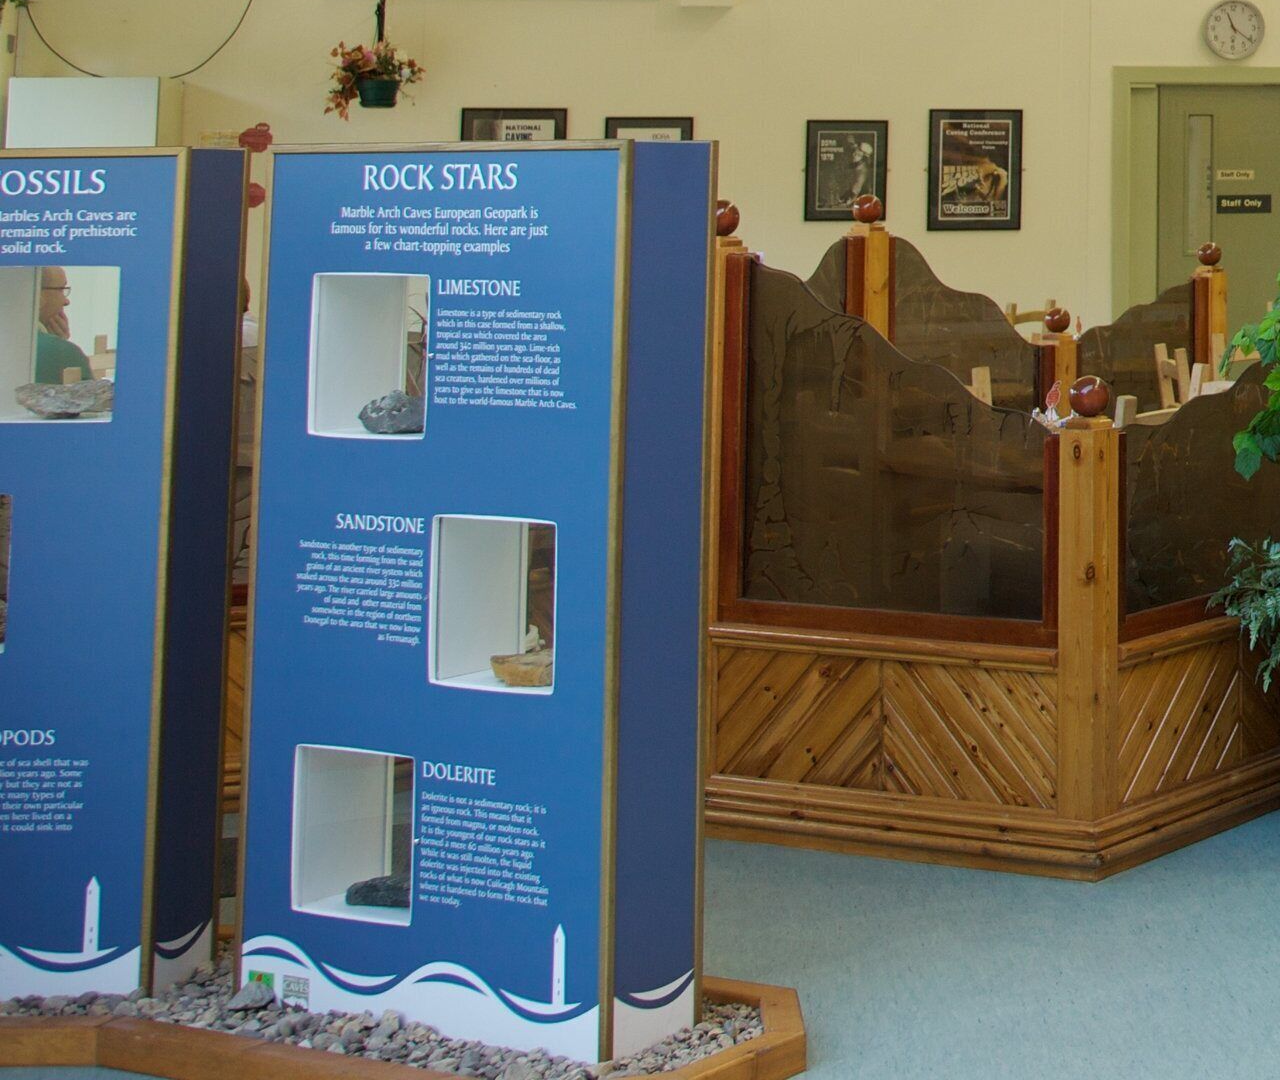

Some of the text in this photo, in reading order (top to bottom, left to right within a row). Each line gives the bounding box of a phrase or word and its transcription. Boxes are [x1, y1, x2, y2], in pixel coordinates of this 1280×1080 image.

[0, 169, 106, 195] OSSILS
[363, 163, 518, 191] ROCK STARS
[944, 204, 989, 214] Welcome
[1221, 199, 1262, 207] Staff Only
[0, 209, 137, 222] arbles Arch Caves are
[341, 206, 538, 222] Marble Arch Caves European Geopark is
[1, 225, 138, 240] remains of prehistoric
[331, 222, 548, 239] famous for its wonderful rocks. Here are just
[1, 241, 66, 253] solid rock.
[365, 238, 510, 255] a few chart-topping examples
[438, 279, 521, 296] LIMESTONE
[438, 309, 468, 318] Limestone
[470, 309, 476, 318] is
[482, 311, 496, 321] type
[497, 310, 505, 318] of
[506, 310, 545, 320] sedimentary
[547, 310, 561, 319] rock
[437, 320, 455, 328] which
[457, 320, 463, 328] in
[464, 320, 476, 328] this
[493, 321, 515, 329] formed
[518, 321, 532, 329] from
[540, 322, 566, 331] shallow,
[437, 330, 460, 340] tropical
[474, 331, 492, 340] which
[494, 332, 519, 340] covered
[522, 332, 531, 341] the
[436, 342, 560, 355] around 340 million years ago. Lime-rich
[452, 353, 470, 361] which
[471, 353, 499, 363] gathered
[510, 354, 522, 362] the
[523, 355, 552, 363] sea-floor,
[436, 363, 448, 371] well
[469, 365, 494, 373] remains
[495, 365, 503, 373] of
[504, 365, 533, 374] hundreds
[535, 366, 542, 374] of
[544, 366, 559, 375] dead
[447, 376, 476, 384] creatures,
[478, 376, 508, 384] hardened
[525, 377, 550, 385] millions
[553, 377, 559, 385] of
[435, 386, 451, 394] years
[461, 387, 473, 396] give
[484, 387, 494, 395] the
[496, 387, 527, 396] limestone
[528, 388, 542, 396] that
[336, 513, 425, 534] SANDSTONE
[0, 730, 55, 746] PODS
[423, 761, 496, 786] DOLERITE
